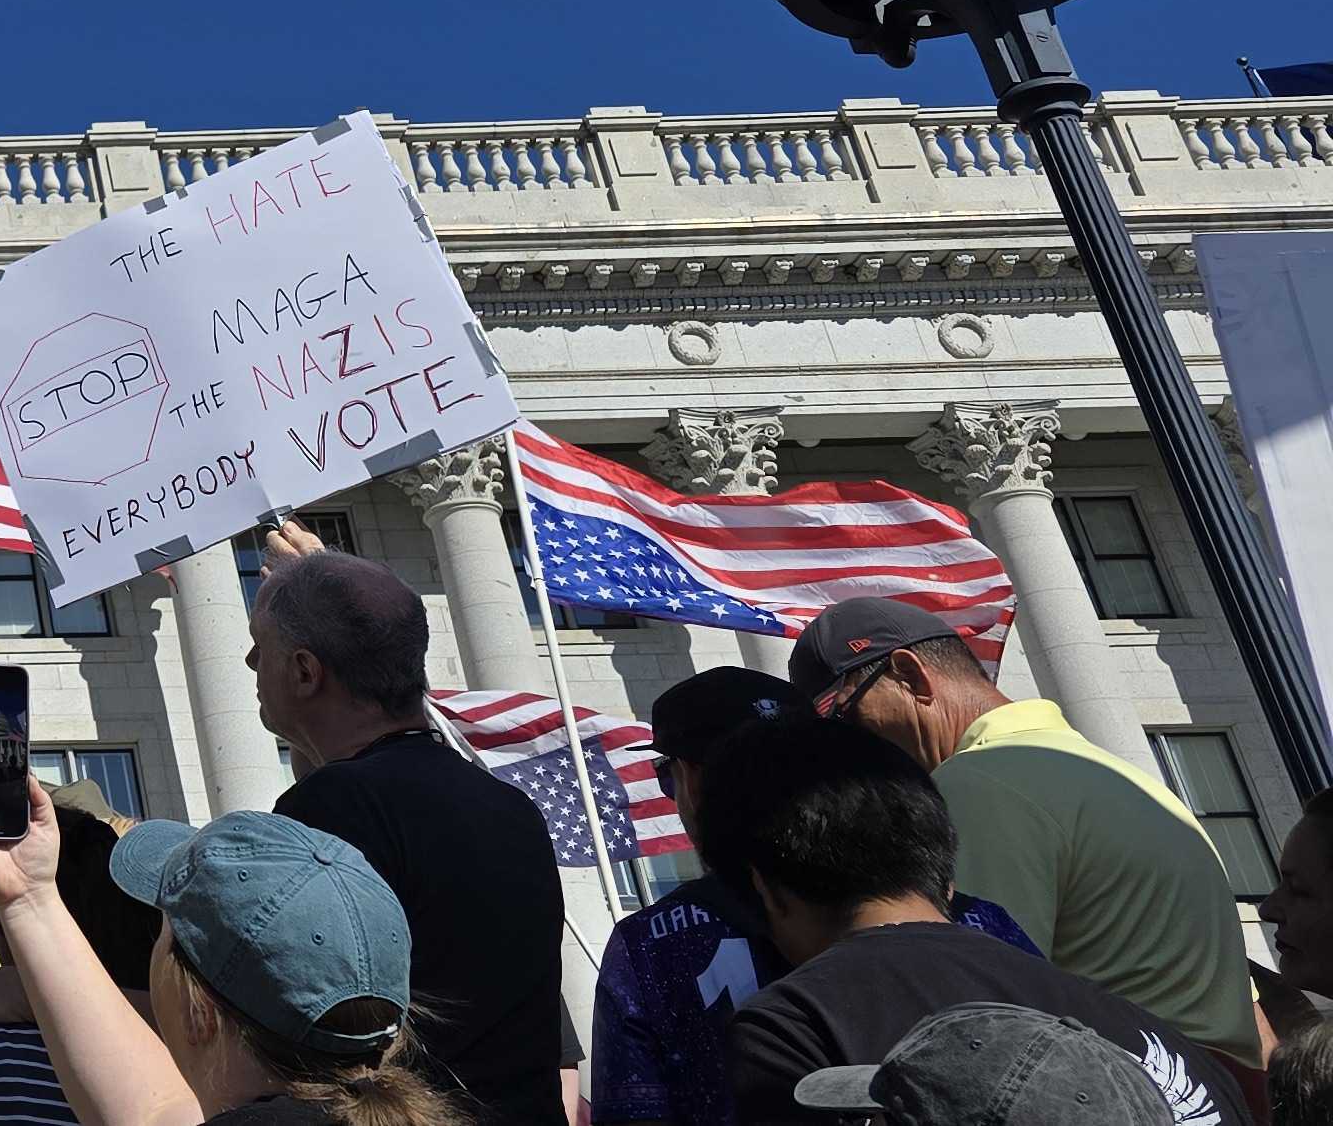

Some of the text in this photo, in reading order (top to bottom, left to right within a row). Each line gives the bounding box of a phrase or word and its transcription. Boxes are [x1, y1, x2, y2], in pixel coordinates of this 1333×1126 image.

[109, 153, 352, 283] THE HATE
[169, 298, 433, 430] THE NAZIS
[213, 253, 377, 354] MAGA
[19, 351, 149, 441] STOP
[63, 356, 484, 559] EVERYBODY VOTE
